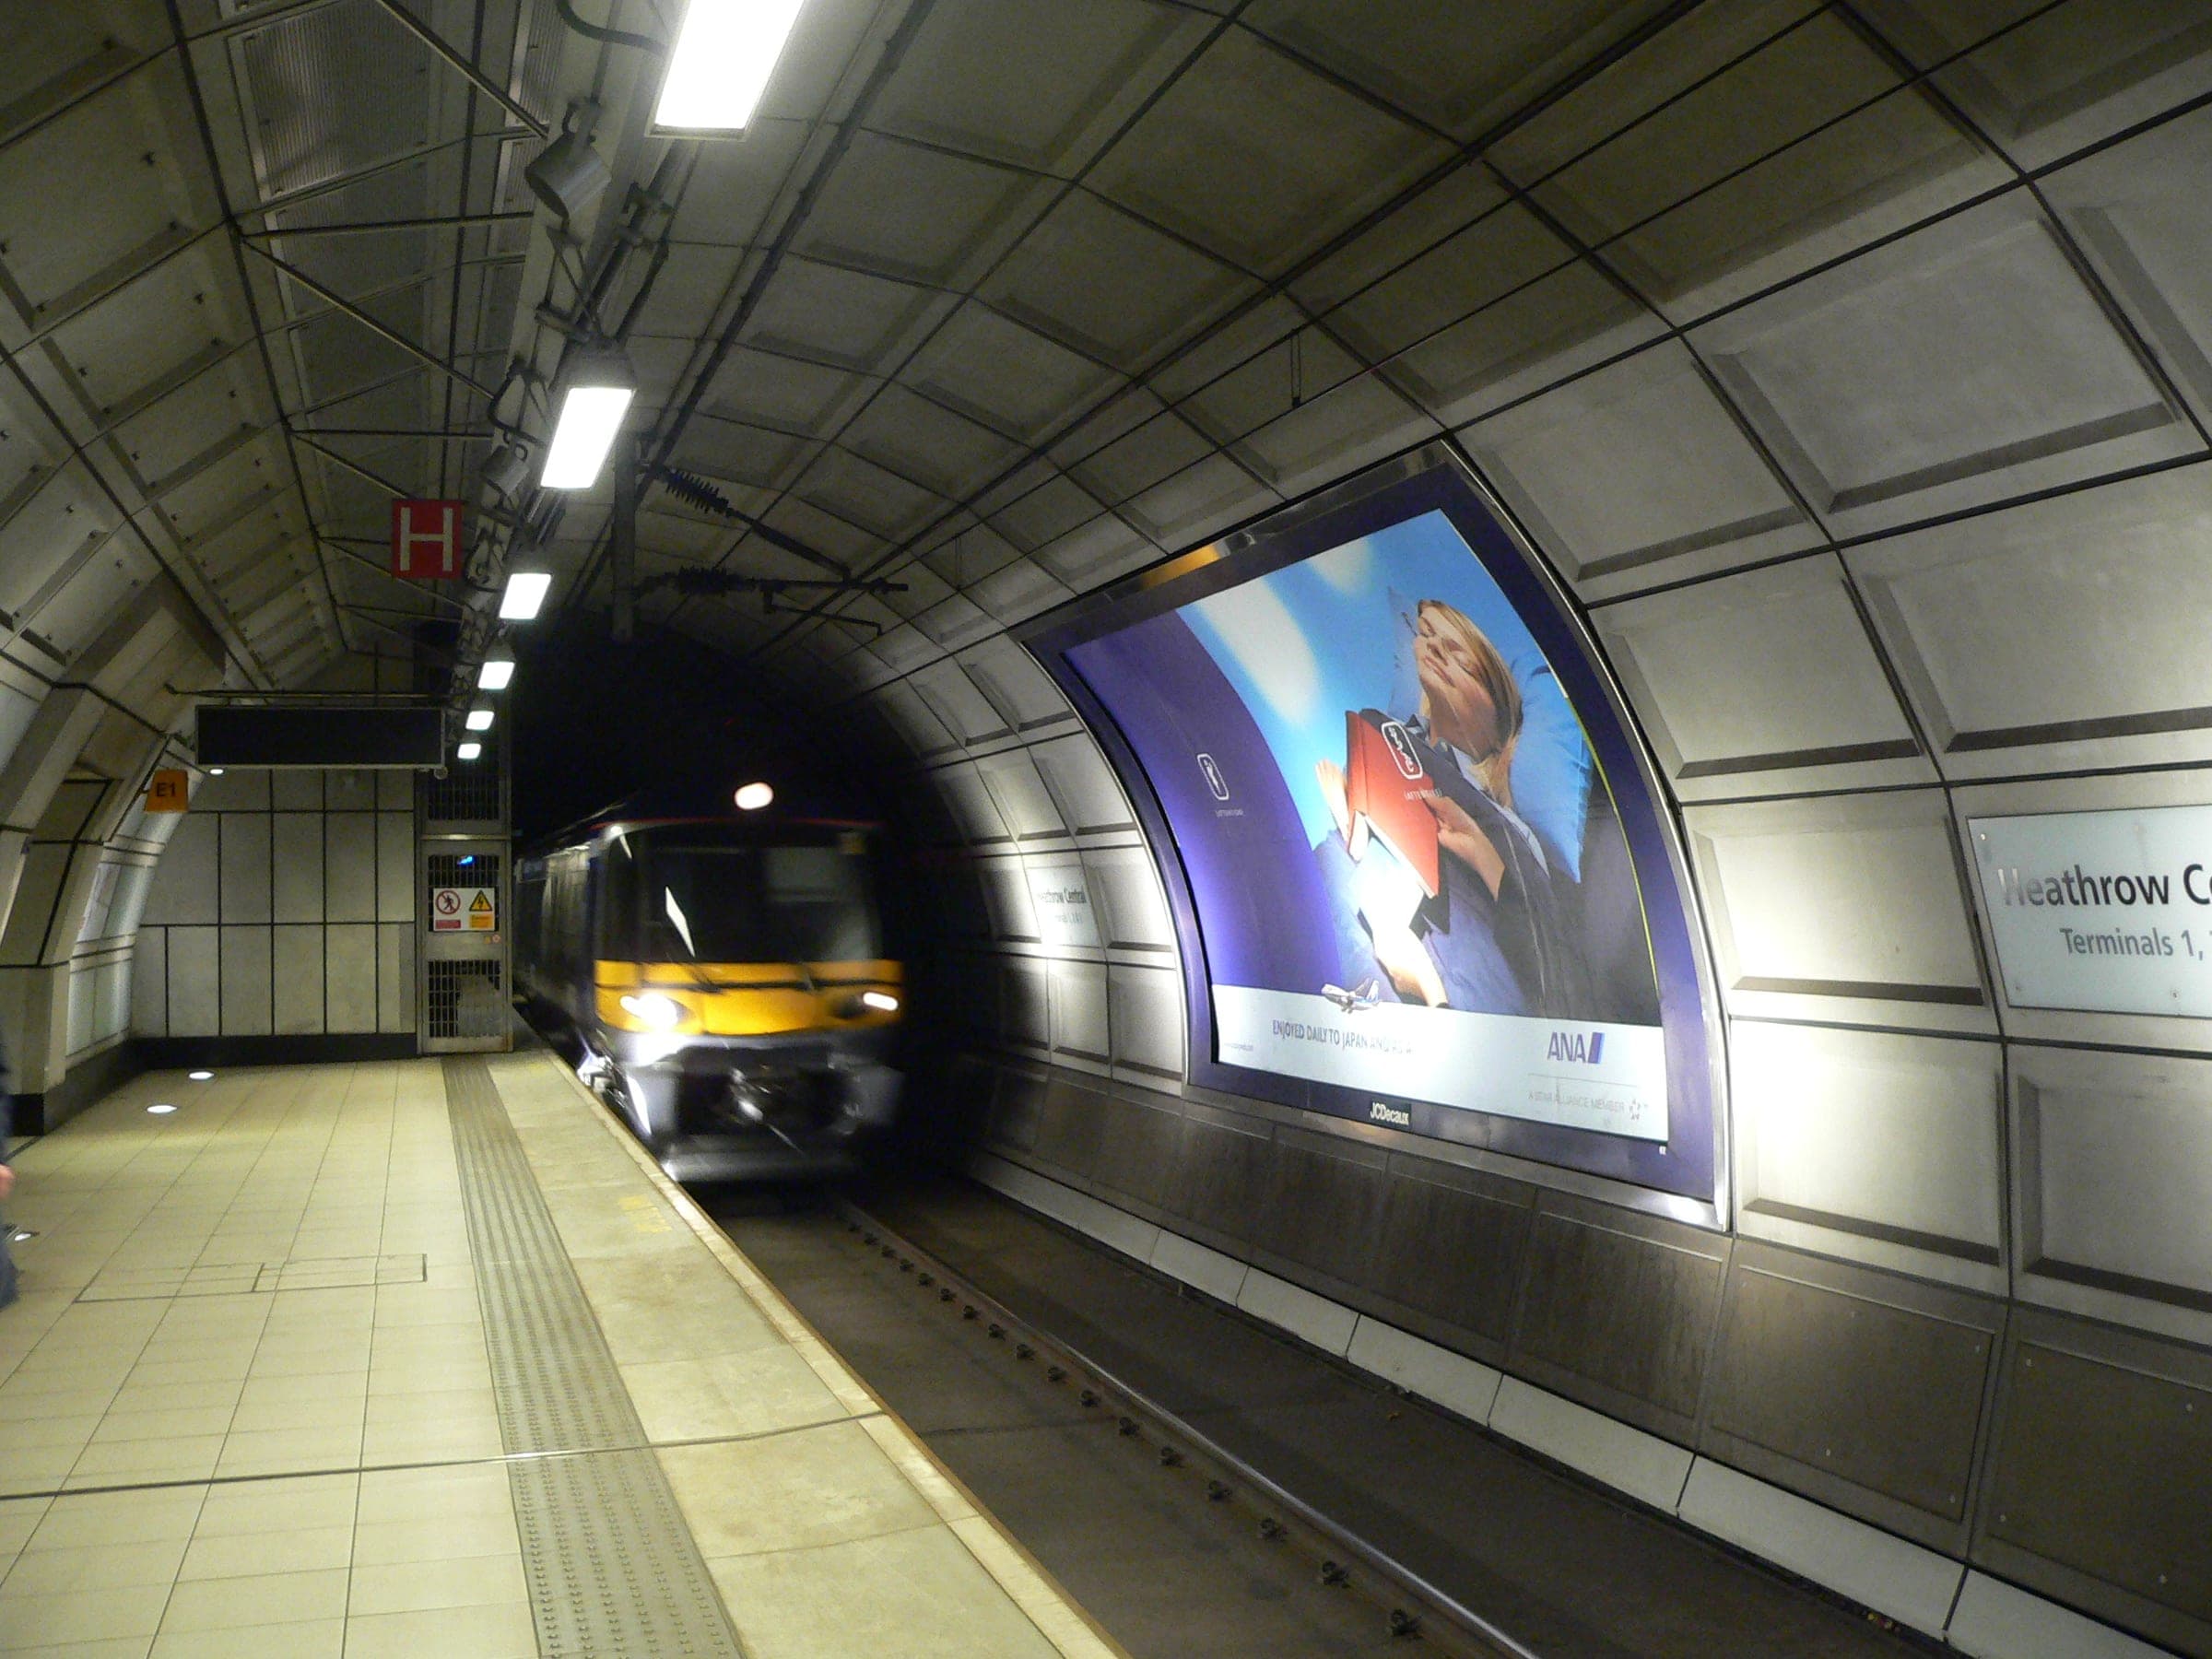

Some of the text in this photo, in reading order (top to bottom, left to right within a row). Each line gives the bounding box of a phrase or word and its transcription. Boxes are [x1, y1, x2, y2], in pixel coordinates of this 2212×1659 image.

[399, 506, 453, 571] H
[156, 781, 176, 797] E1
[1997, 863, 2212, 906] Heathrow C
[2059, 927, 2173, 957] Terminals
[2181, 929, 2204, 961] 1,
[1272, 1019, 1305, 1040] ENJOYED
[1306, 1024, 1327, 1043] DAILY
[1328, 1028, 1341, 1046] TO
[1342, 1031, 1369, 1051] JAPAN
[1547, 1031, 1587, 1064] ANA
[1370, 1101, 1409, 1126] JCDecaux
